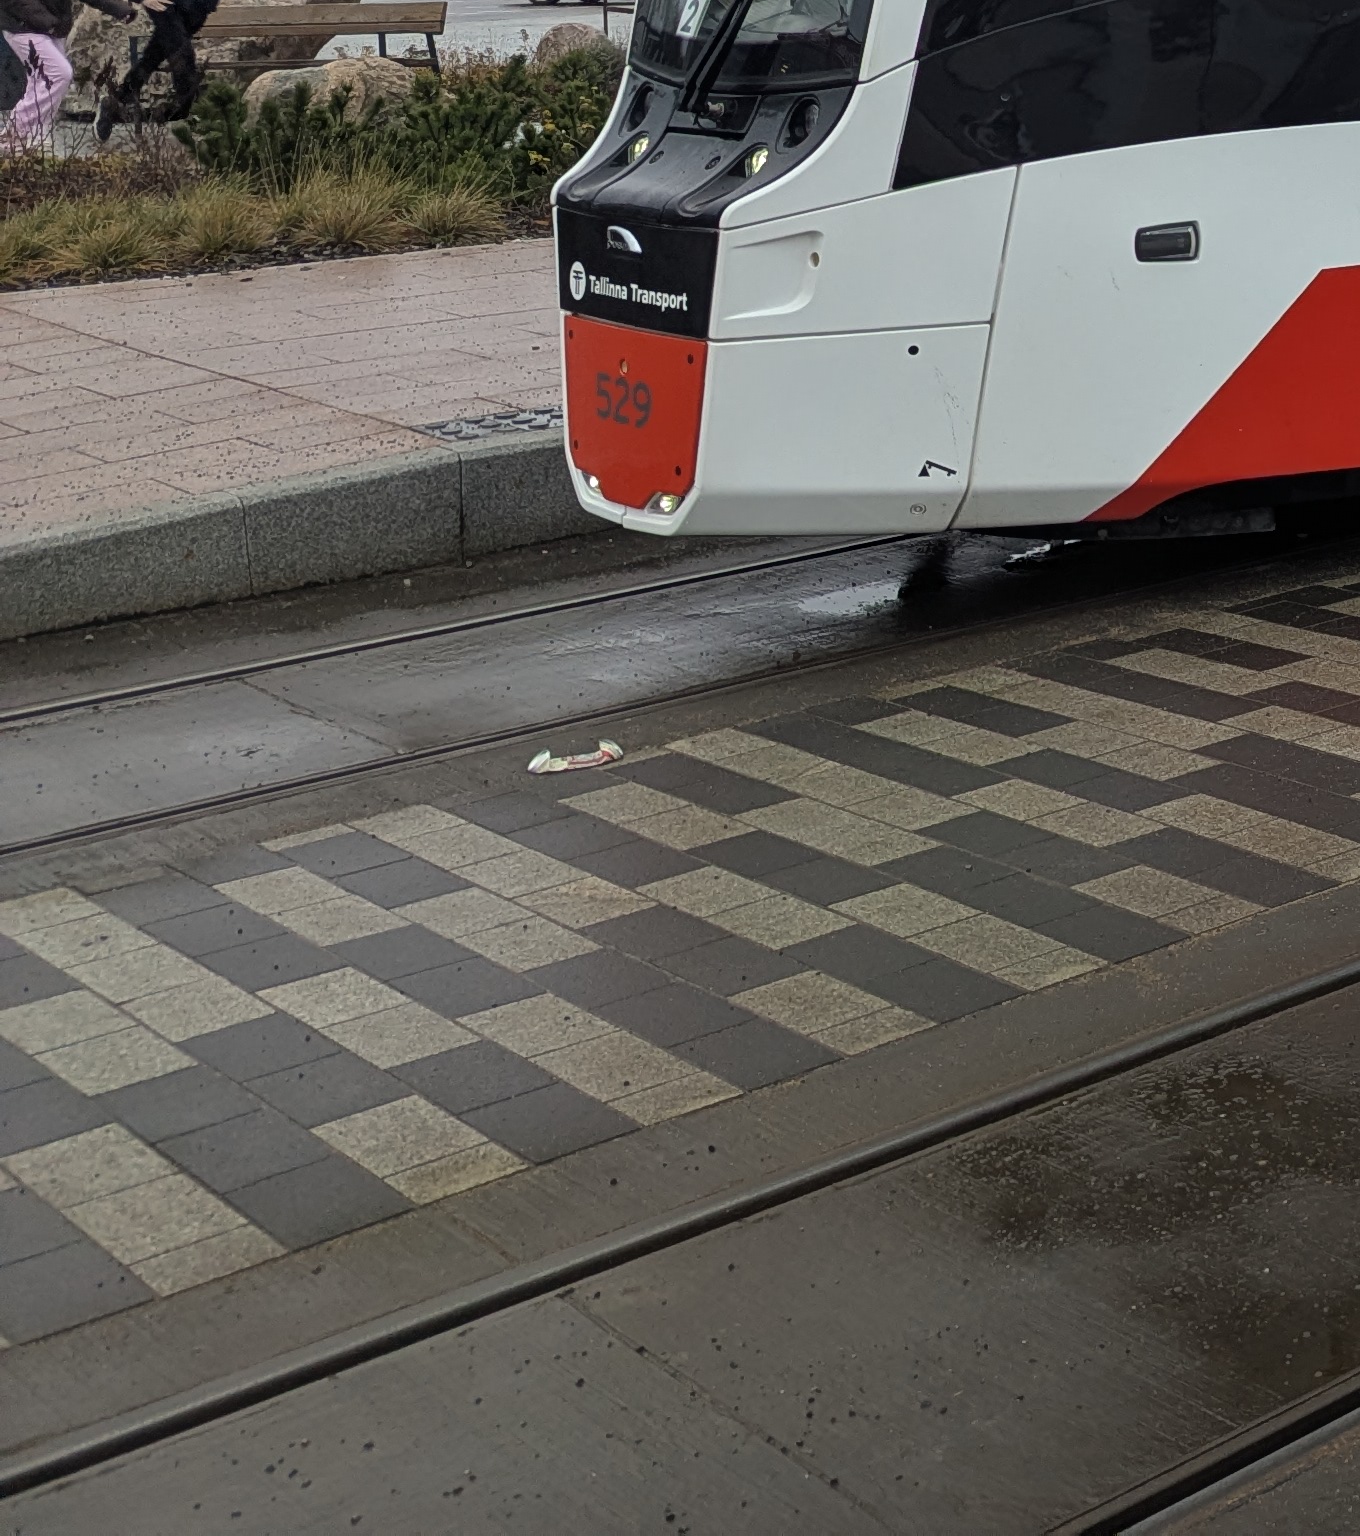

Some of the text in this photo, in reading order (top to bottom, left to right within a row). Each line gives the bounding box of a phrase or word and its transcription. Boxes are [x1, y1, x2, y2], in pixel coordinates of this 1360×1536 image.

[680, 0, 700, 33] 2
[589, 274, 688, 312] Tallinna Transport
[595, 371, 653, 429] 529
